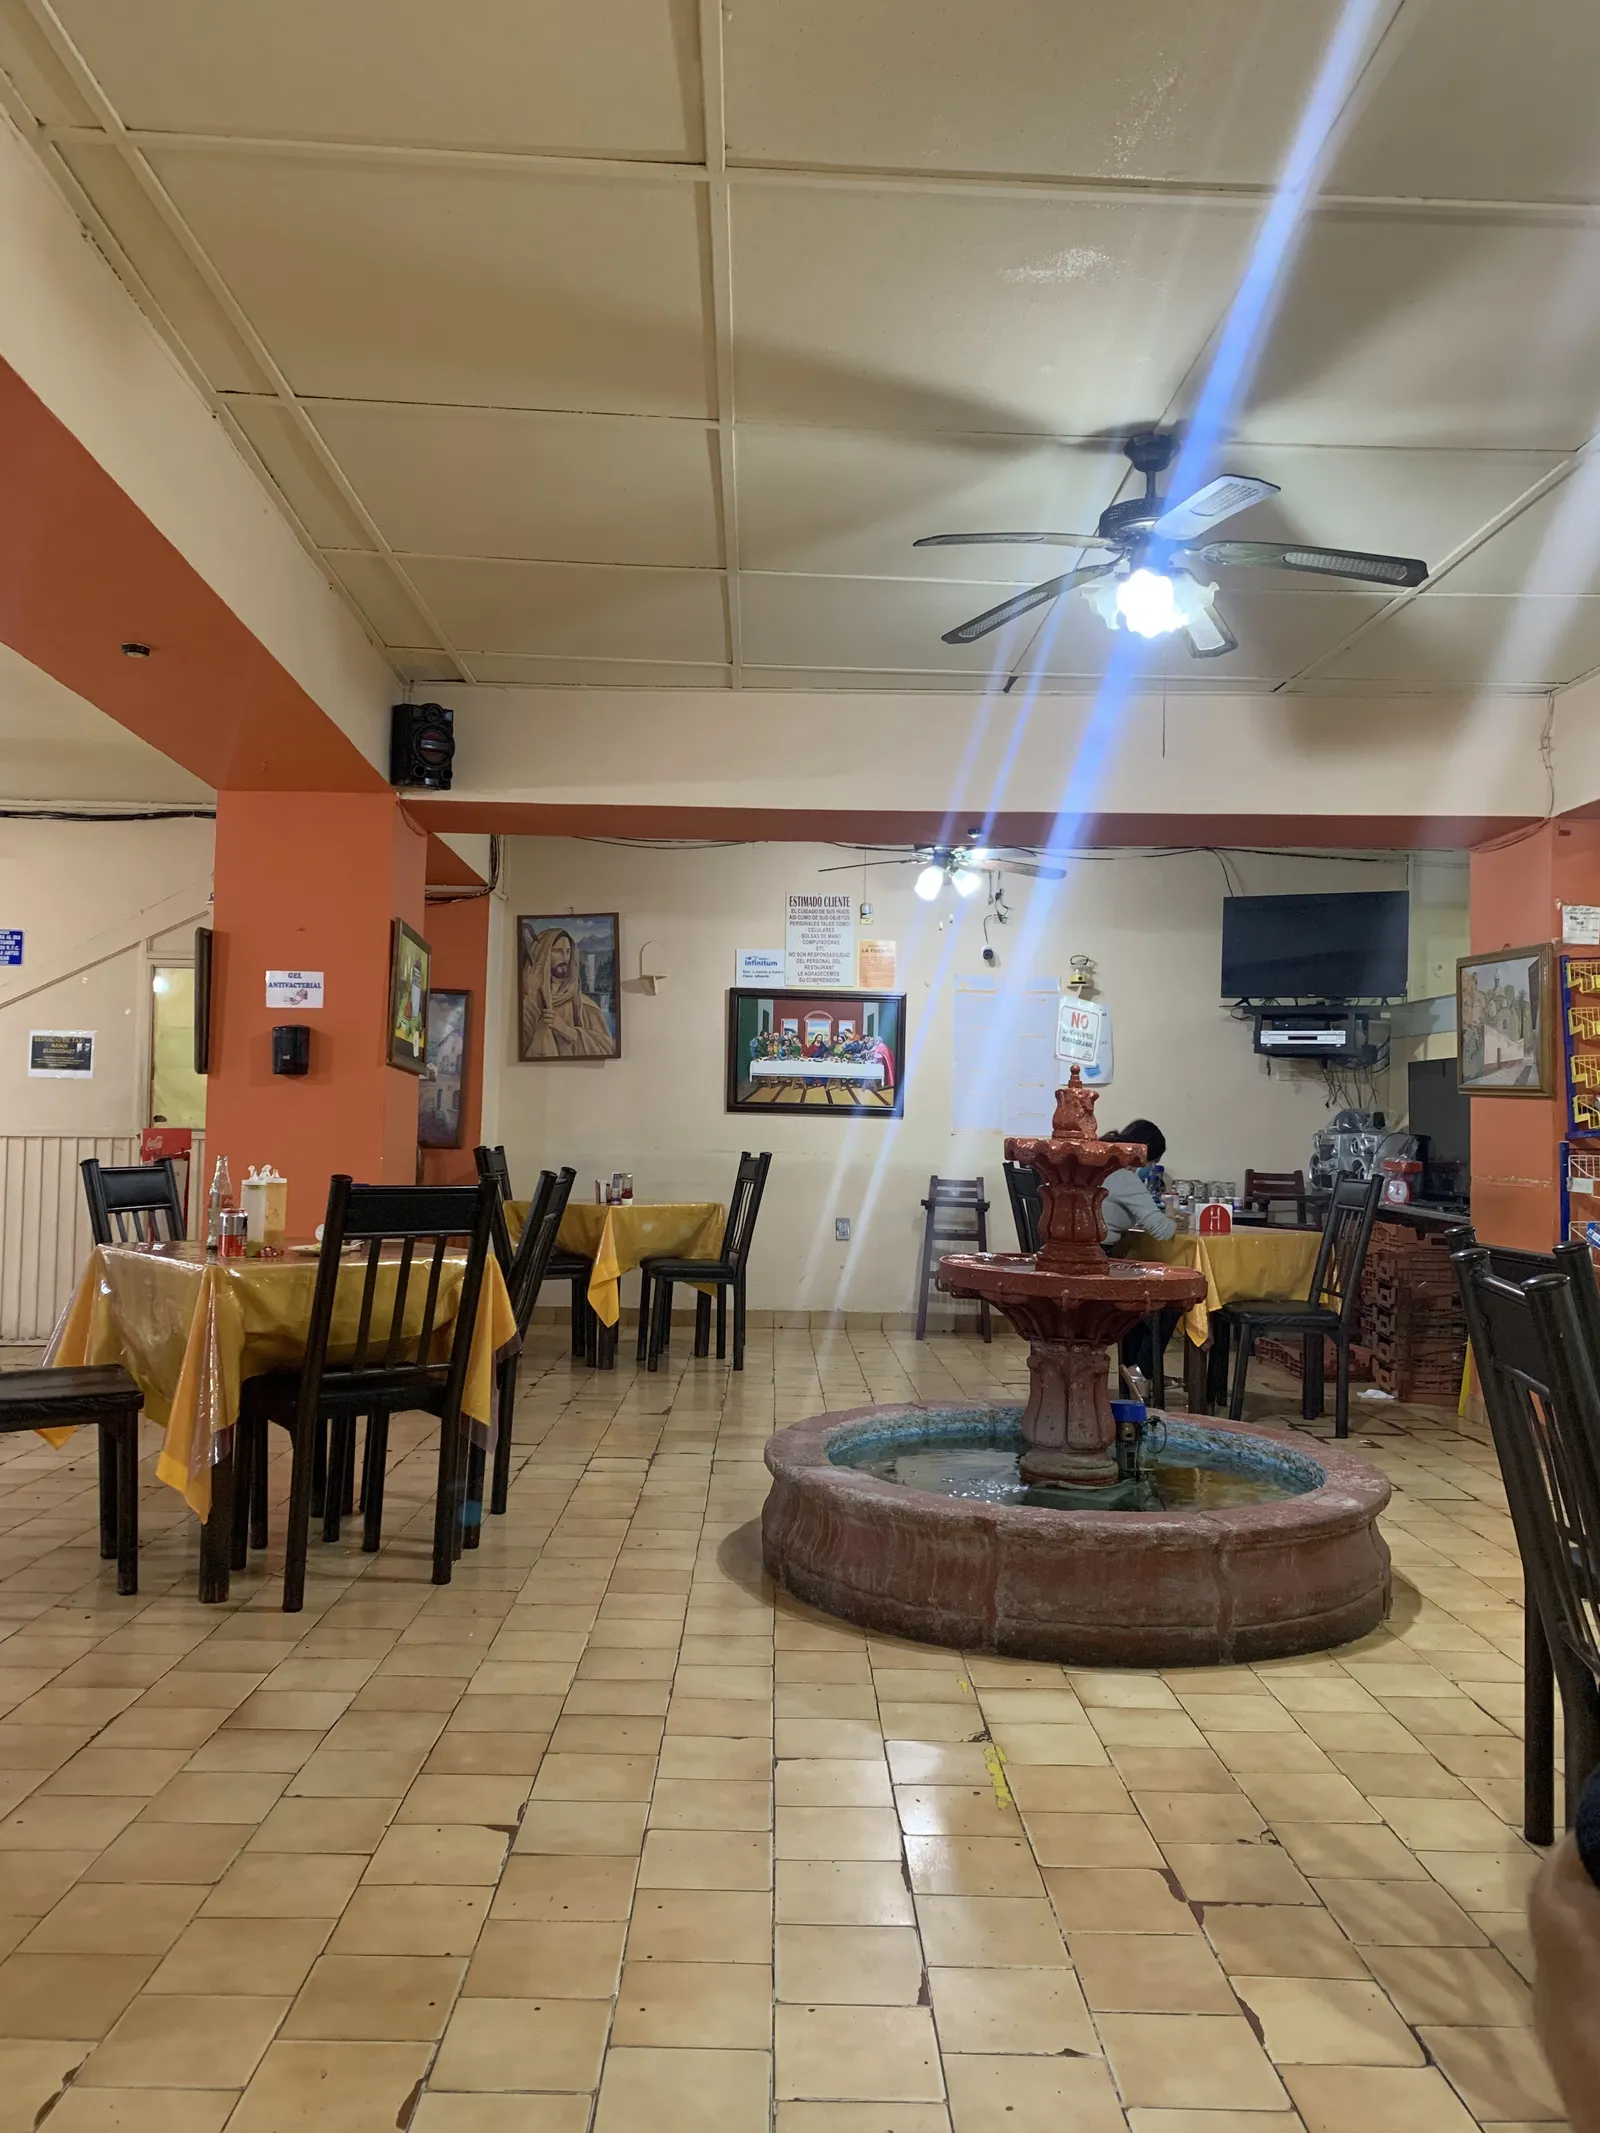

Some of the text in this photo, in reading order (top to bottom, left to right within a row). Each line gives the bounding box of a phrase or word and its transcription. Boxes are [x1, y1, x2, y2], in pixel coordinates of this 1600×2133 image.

[789, 896, 850, 907] ESTIMADO CLIENTE
[1071, 1012, 1089, 1030] NO
